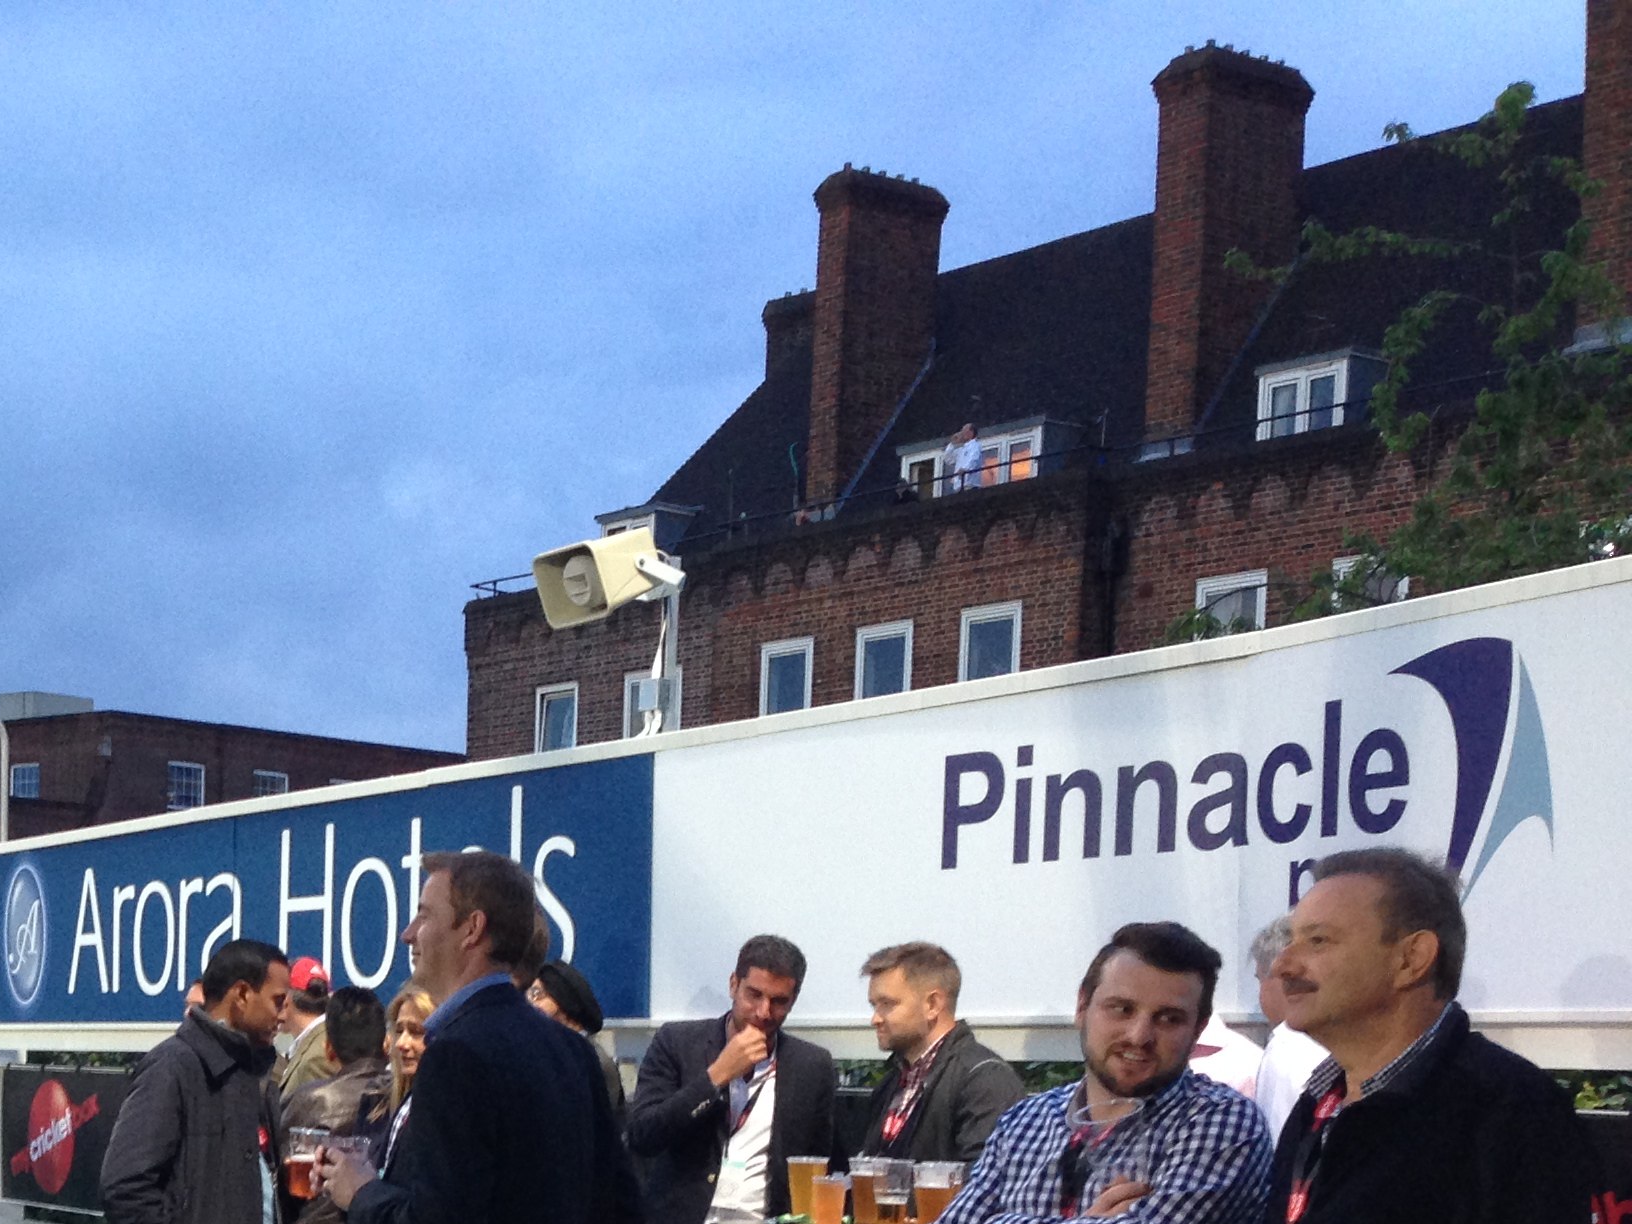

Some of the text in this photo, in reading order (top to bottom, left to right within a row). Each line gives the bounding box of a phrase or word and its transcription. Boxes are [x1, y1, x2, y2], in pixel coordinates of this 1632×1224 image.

[940, 699, 1410, 870] Pinnacle
[67, 785, 576, 996] Arora Hots
